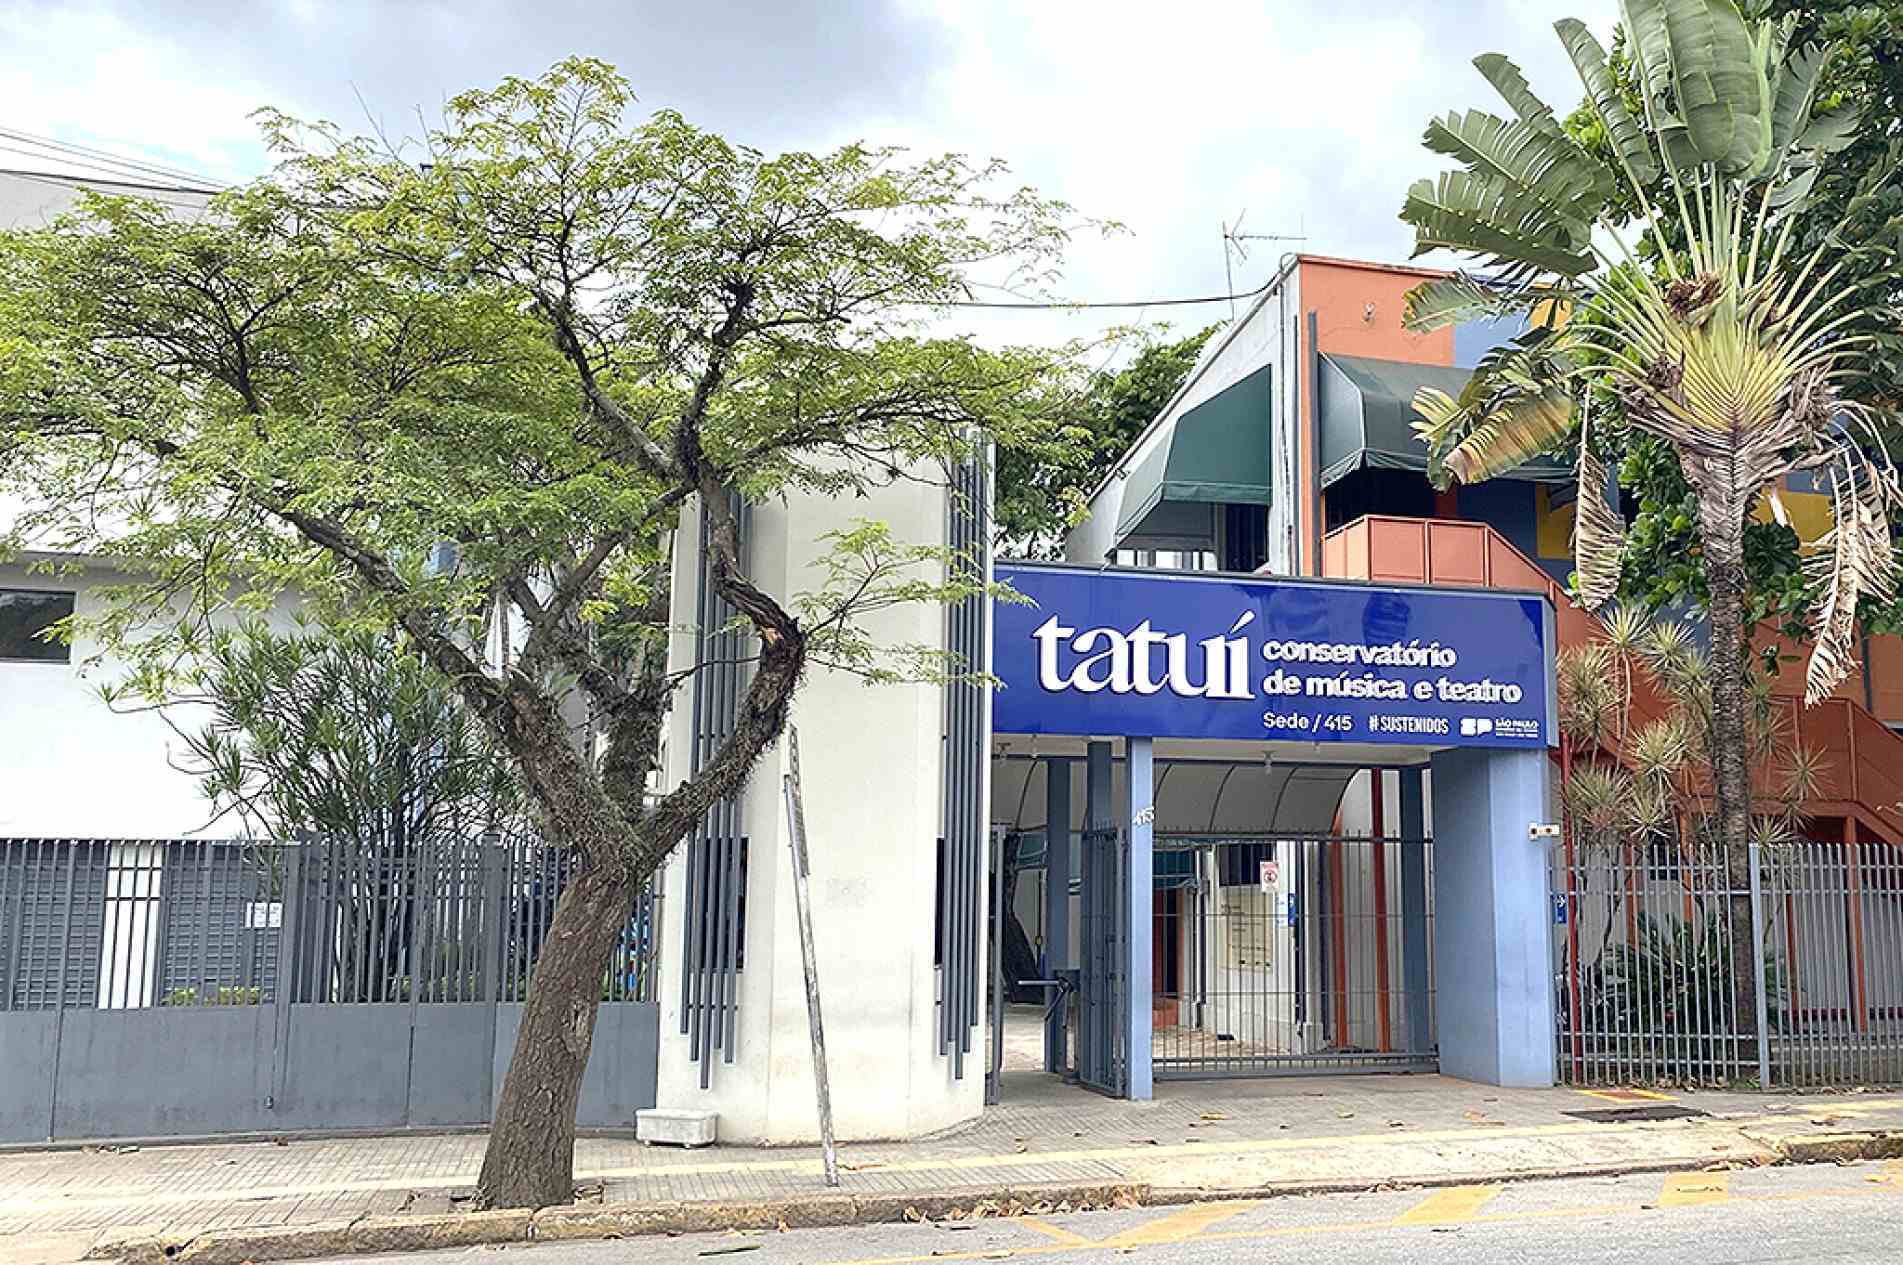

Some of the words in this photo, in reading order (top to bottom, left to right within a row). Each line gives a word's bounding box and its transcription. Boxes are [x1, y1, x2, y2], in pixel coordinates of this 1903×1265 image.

[1033, 609, 1255, 700] tatuí
[1263, 639, 1457, 668] conservatório
[1263, 670, 1300, 697] de
[1306, 671, 1406, 701] música
[1414, 680, 1433, 701] e
[1437, 676, 1522, 703] teatro
[1263, 712, 1309, 731] Sede
[1312, 714, 1322, 733] /
[1324, 715, 1352, 731] 415
[1369, 715, 1449, 735] #SUSTENIDOS
